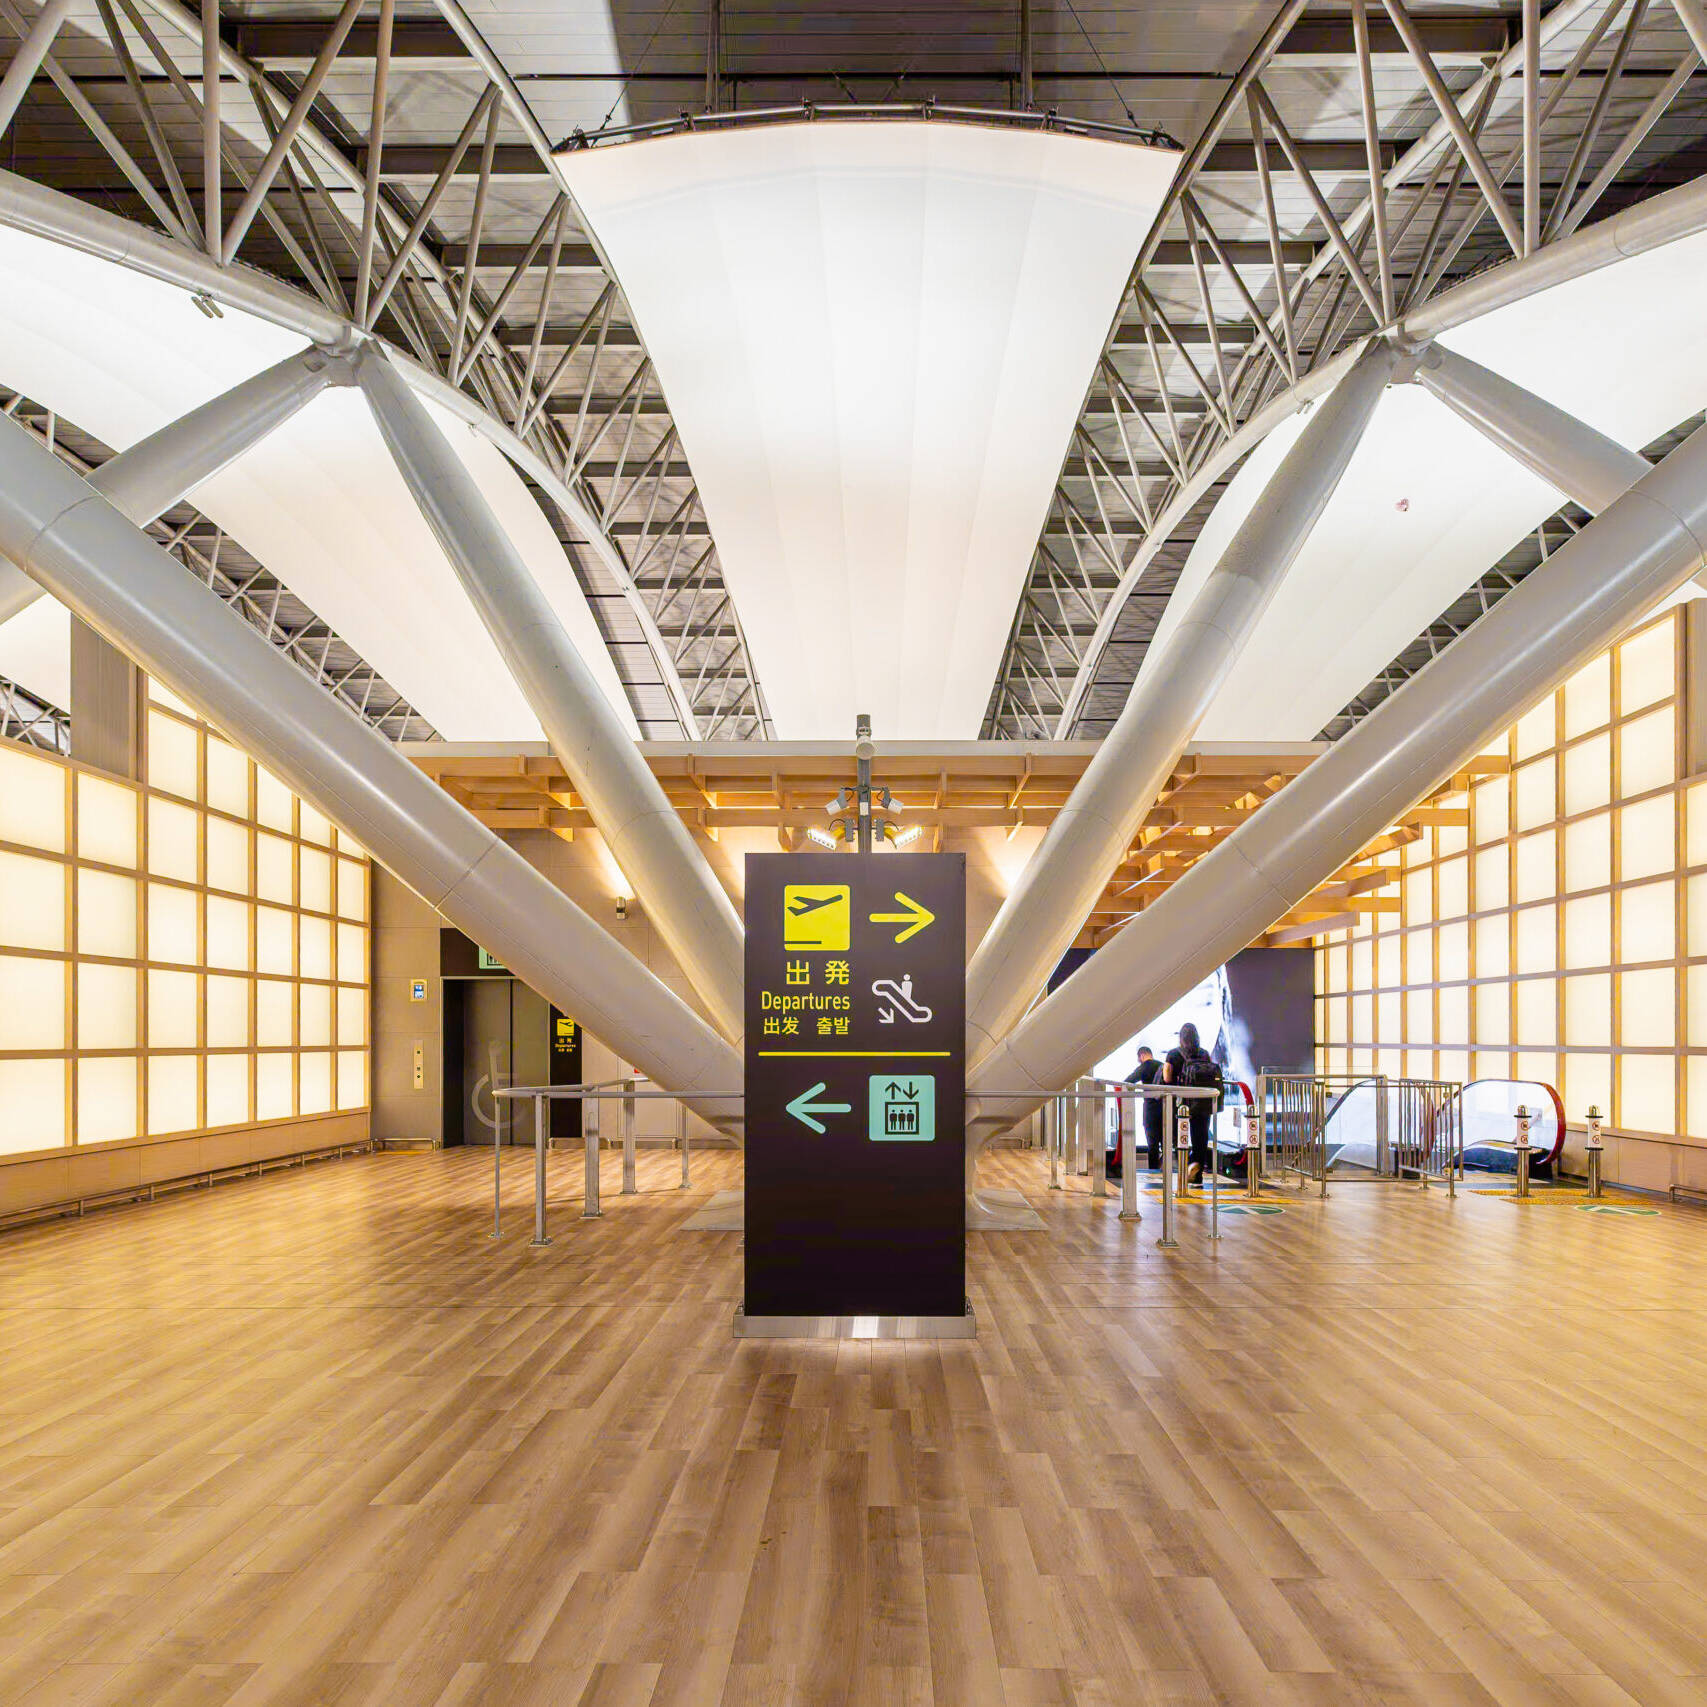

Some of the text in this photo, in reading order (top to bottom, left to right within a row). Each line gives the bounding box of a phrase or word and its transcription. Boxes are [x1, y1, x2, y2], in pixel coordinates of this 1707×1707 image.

[786, 960, 849, 985] 出発
[761, 991, 850, 1014] Departures
[763, 1017, 850, 1035] 出发 출발
